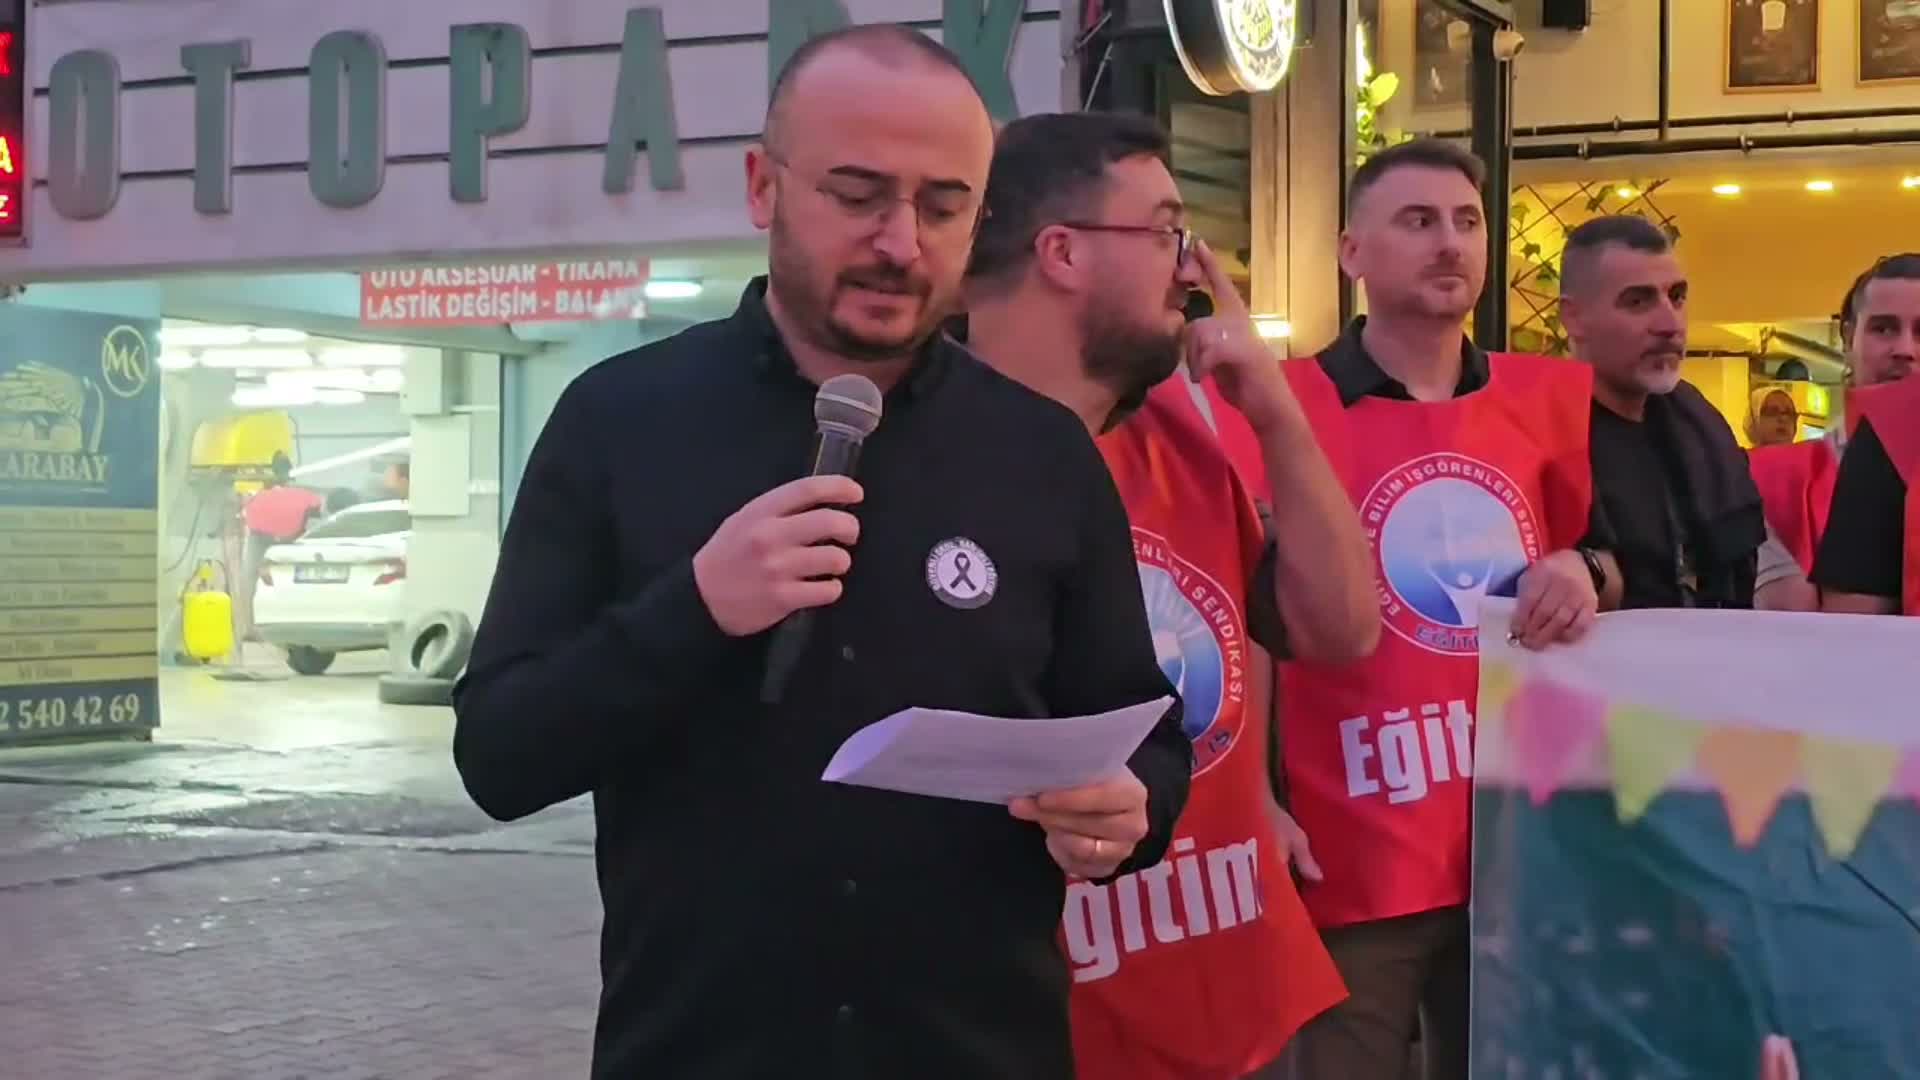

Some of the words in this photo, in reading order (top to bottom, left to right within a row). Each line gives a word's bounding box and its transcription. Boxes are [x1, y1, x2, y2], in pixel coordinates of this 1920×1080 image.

[366, 291, 443, 321] LASTİK
[446, 286, 537, 322] DEĞİŞİM
[0, 451, 108, 481] ARABAY
[18, 698, 66, 729] 540
[72, 696, 103, 725] 42
[109, 693, 139, 723] 69
[1339, 699, 1474, 805] Eğit
[1062, 837, 1264, 984] ğitim
